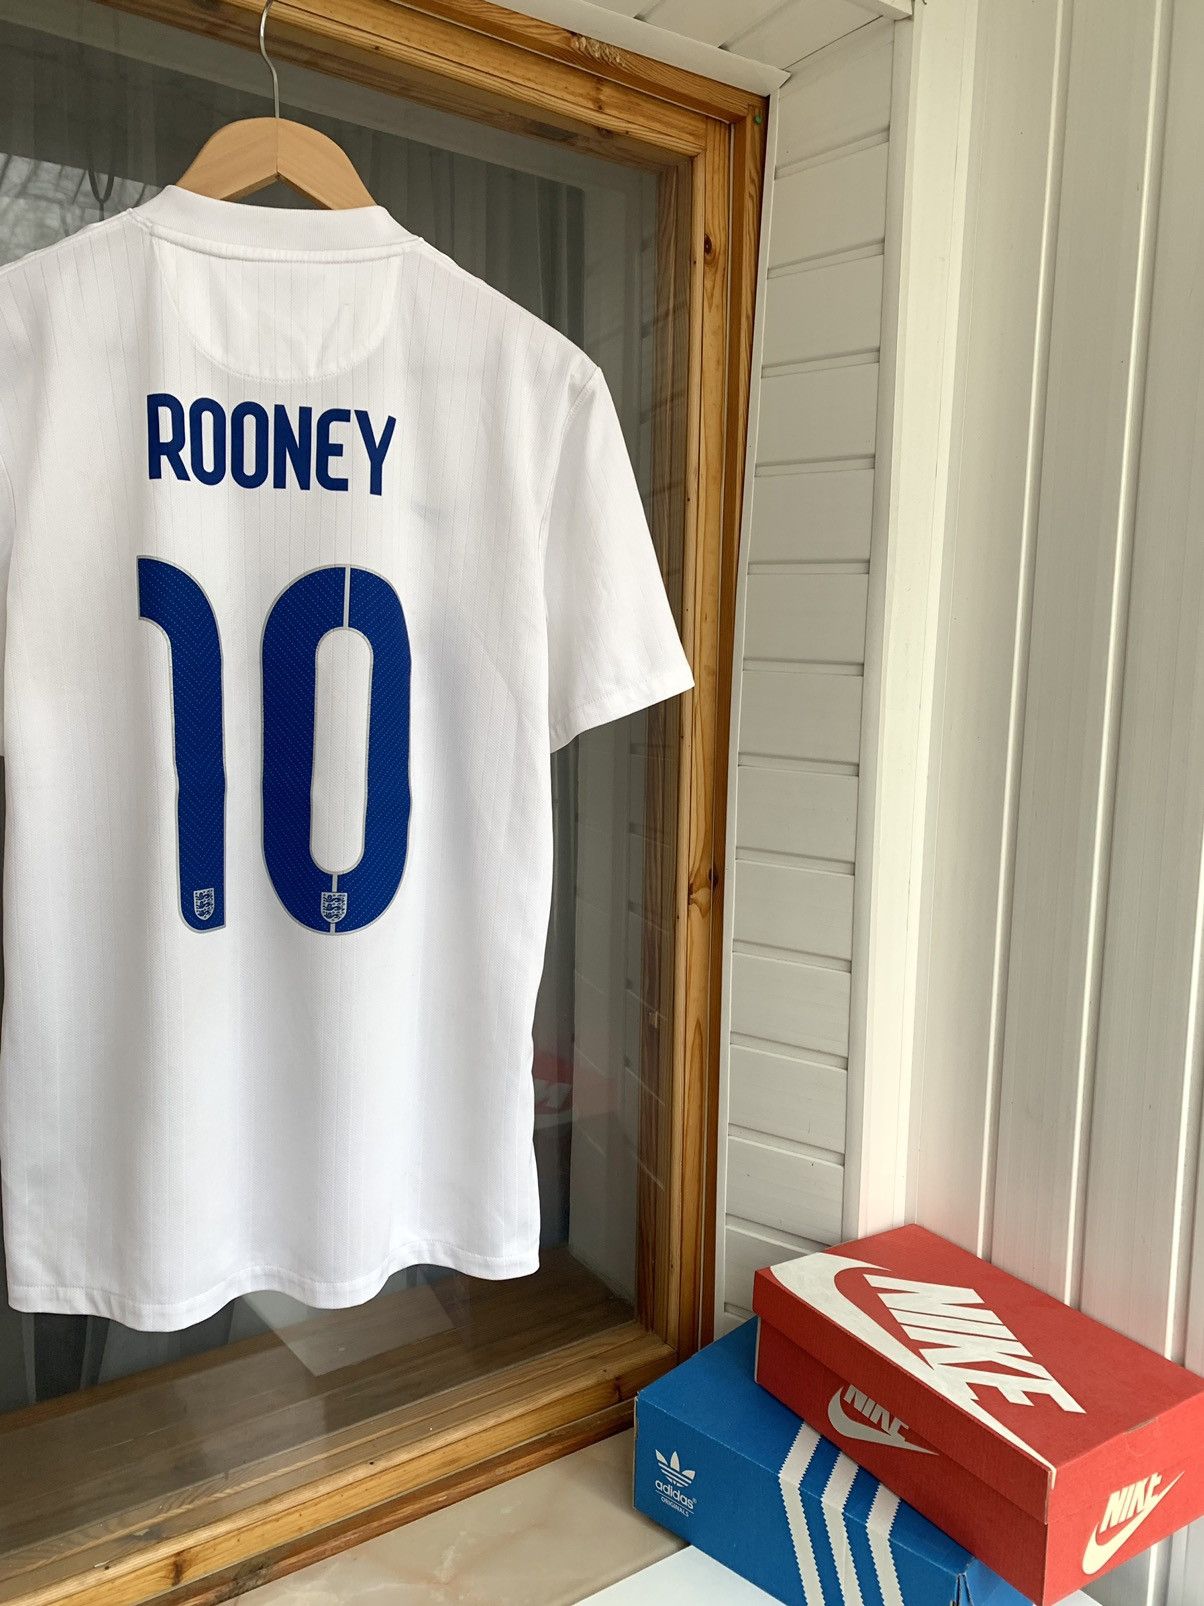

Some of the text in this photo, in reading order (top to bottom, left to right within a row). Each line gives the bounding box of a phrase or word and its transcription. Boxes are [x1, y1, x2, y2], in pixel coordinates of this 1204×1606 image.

[147, 393, 396, 496] ROONEY
[136, 555, 412, 935] 10
[863, 1273, 1087, 1414] NIKE
